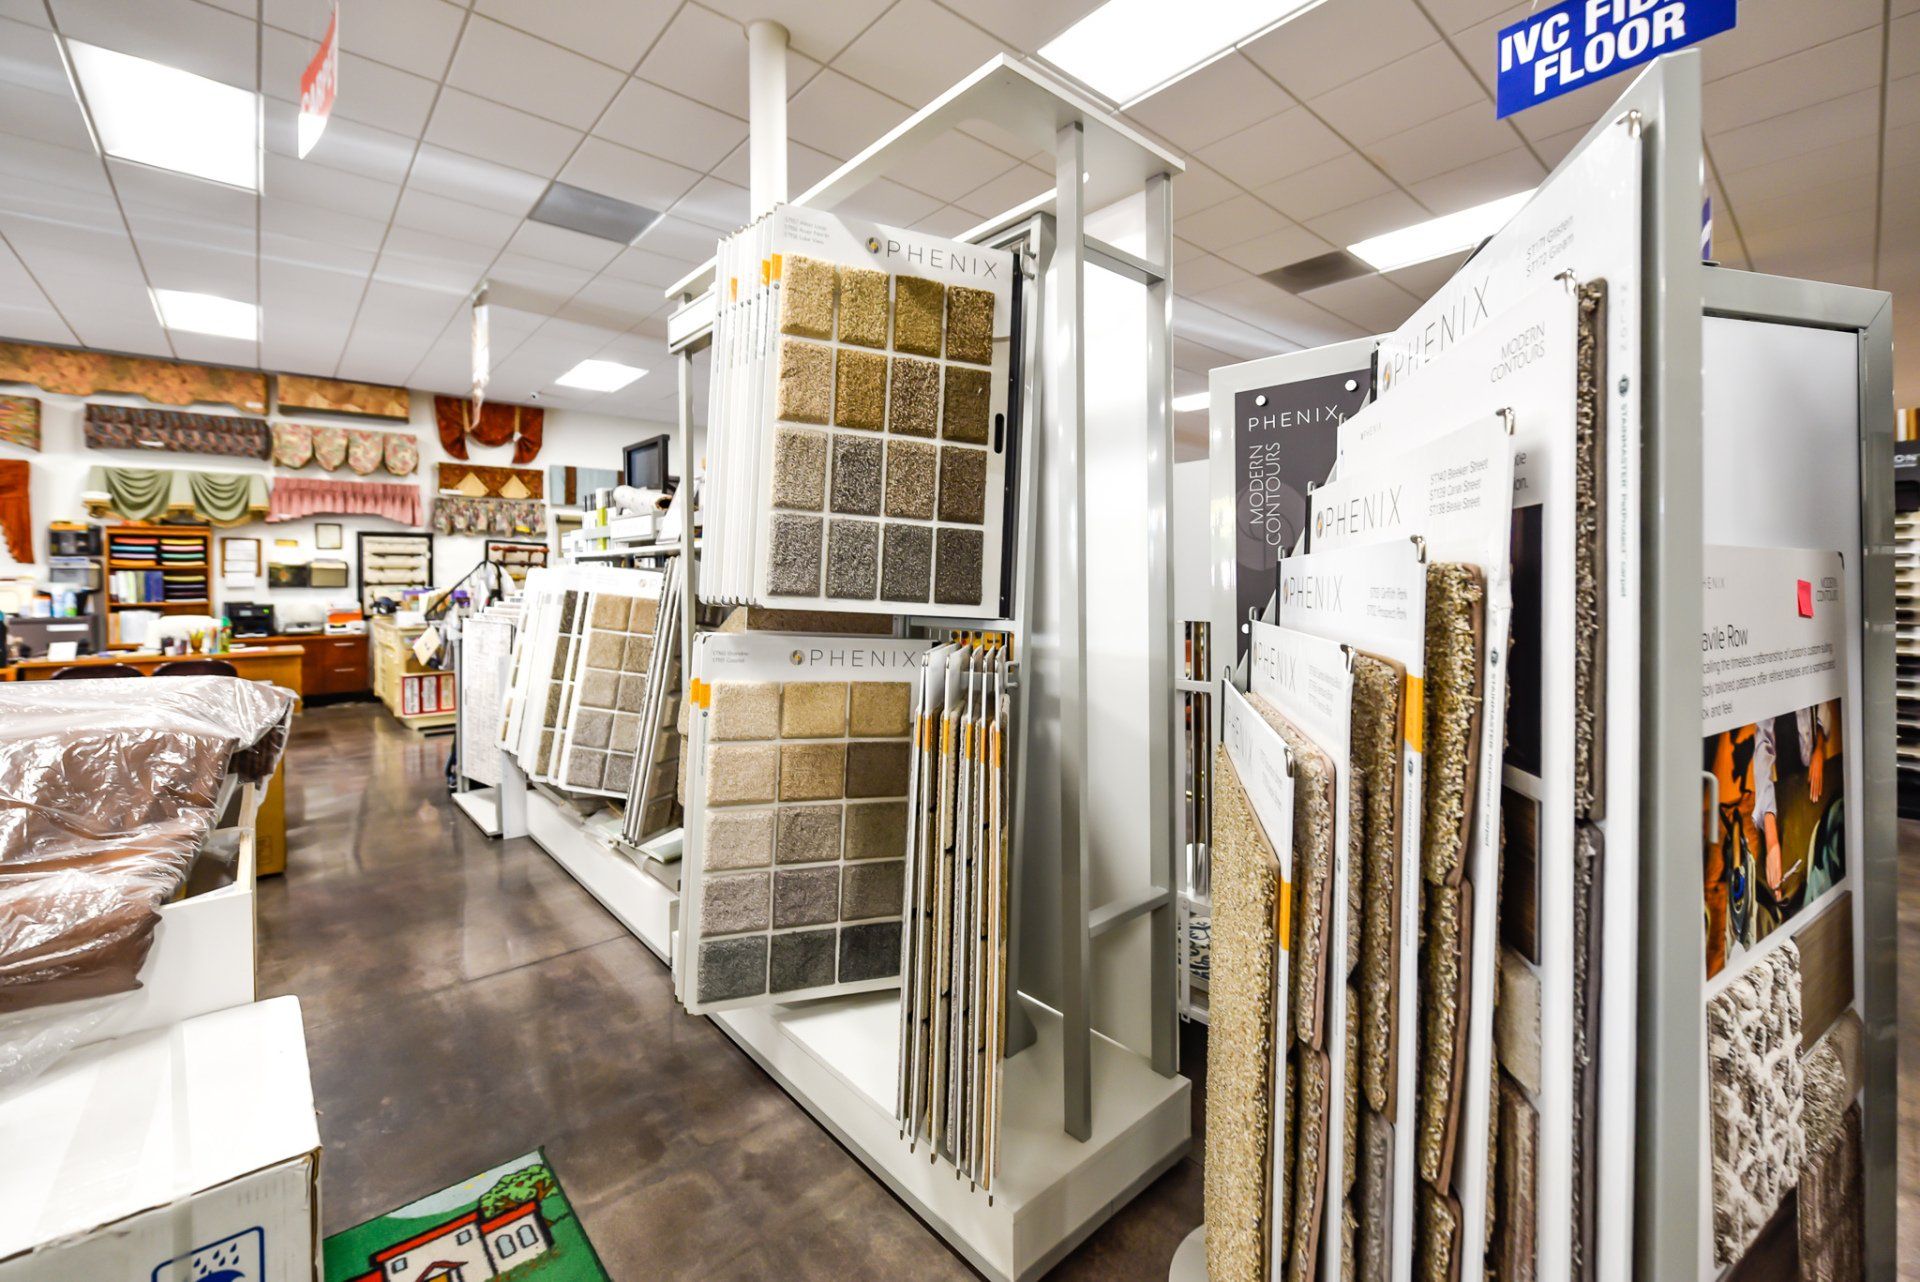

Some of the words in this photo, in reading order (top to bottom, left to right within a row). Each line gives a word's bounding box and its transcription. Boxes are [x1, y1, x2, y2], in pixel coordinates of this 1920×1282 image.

[1501, 12, 1569, 73] IVC
[1534, 2, 1687, 95] FLOOR
[887, 239, 998, 280] PHENIX
[1394, 276, 1489, 387] PHENIX
[1501, 321, 1545, 361] MODERN
[1490, 340, 1546, 382] CONTOURS
[1248, 404, 1338, 432] PHENIX
[1249, 445, 1264, 525] MODERN
[1463, 478, 1482, 493] Street
[1470, 458, 1489, 474] Street
[1265, 442, 1282, 546] CONTOURS
[1325, 484, 1402, 539] PHENIX
[1463, 495, 1481, 511] Street
[1289, 575, 1343, 613] PHENIX
[1702, 625, 1725, 652] avile
[1727, 624, 1748, 648] Row
[810, 649, 917, 668] PHENIX
[1721, 658, 1731, 669] the
[1731, 654, 1752, 669] timeless
[1736, 677, 1757, 691] patterns
